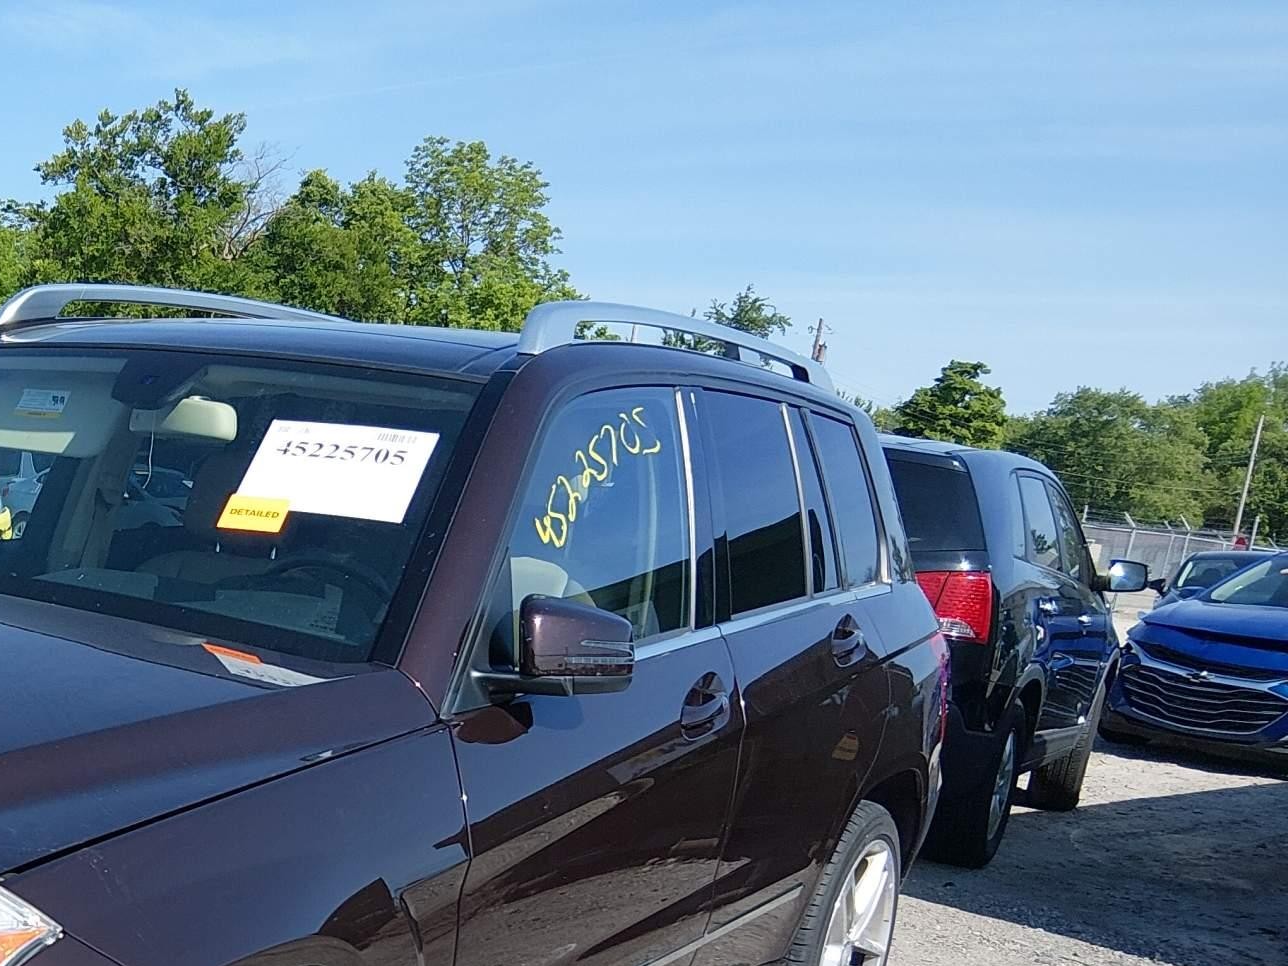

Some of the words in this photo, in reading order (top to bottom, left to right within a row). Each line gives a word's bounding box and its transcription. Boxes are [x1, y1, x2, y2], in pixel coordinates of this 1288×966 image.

[277, 440, 408, 466] 45225705
[535, 406, 661, 548] 45225705
[229, 508, 280, 519] DETAILED
